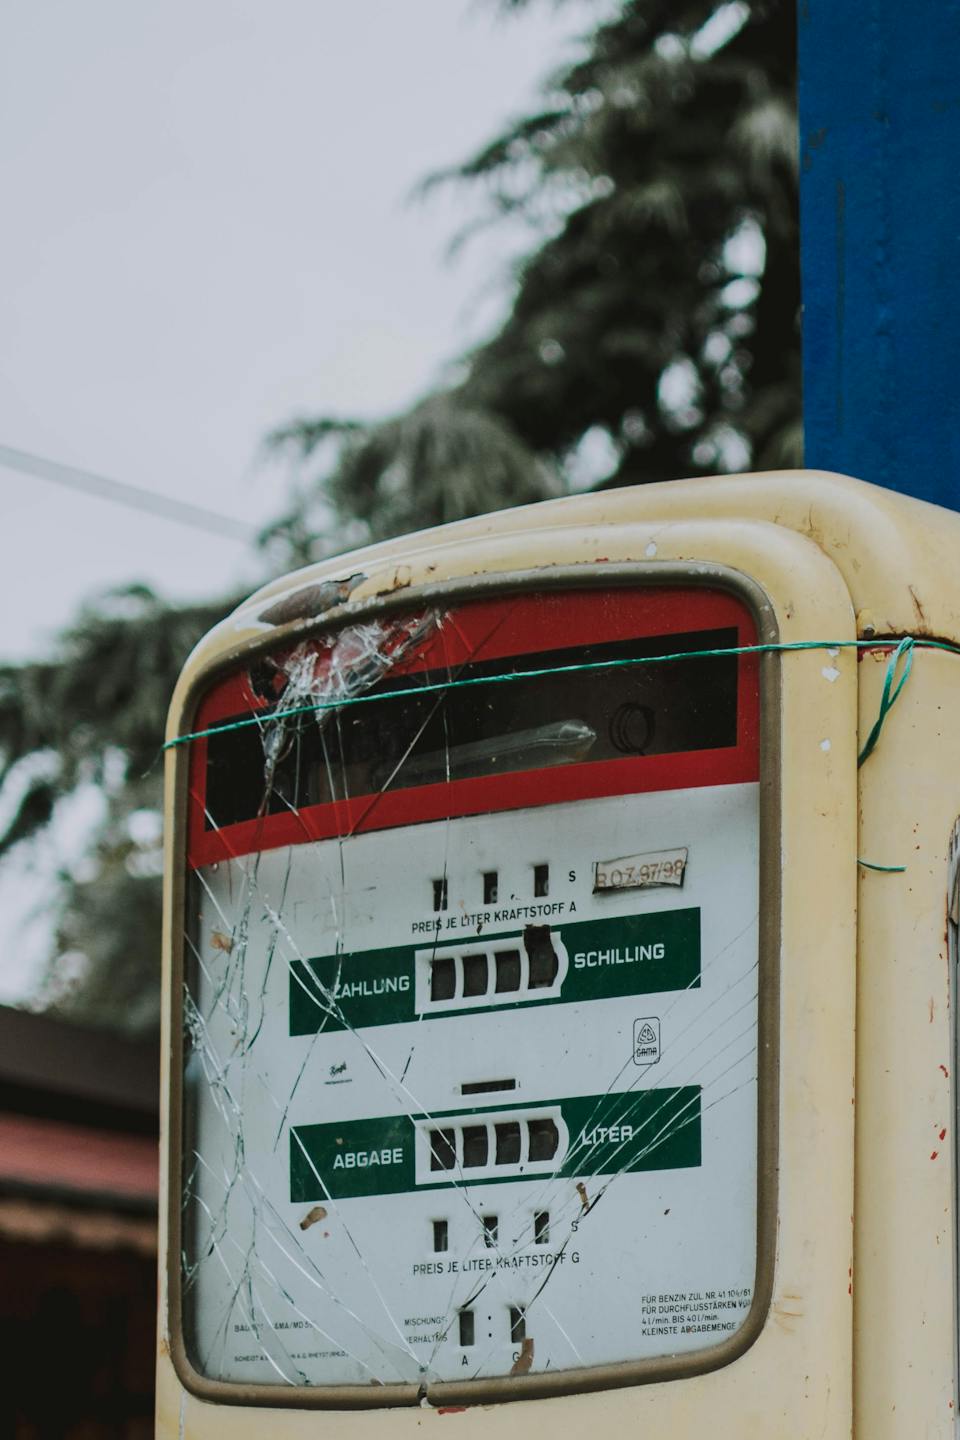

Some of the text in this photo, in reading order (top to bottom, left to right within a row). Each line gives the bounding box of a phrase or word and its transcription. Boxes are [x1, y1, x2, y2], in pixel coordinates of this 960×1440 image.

[568, 870, 576, 882] S
[412, 901, 577, 934] PREIS JE LITER KRAFTSTOFF A
[333, 943, 665, 999] ZAHLUNG SCHILLING
[333, 1125, 633, 1169] ABGABE LITER
[413, 1262, 444, 1275] PREIS
[447, 1261, 459, 1272] JE
[571, 1251, 580, 1264] G
[658, 1293, 686, 1303] BENZIN
[672, 1315, 685, 1324] BIS
[641, 1322, 737, 1336] KLEINSTE ABGABEMENGE
[461, 1354, 469, 1366] A
[512, 1351, 521, 1363] G
